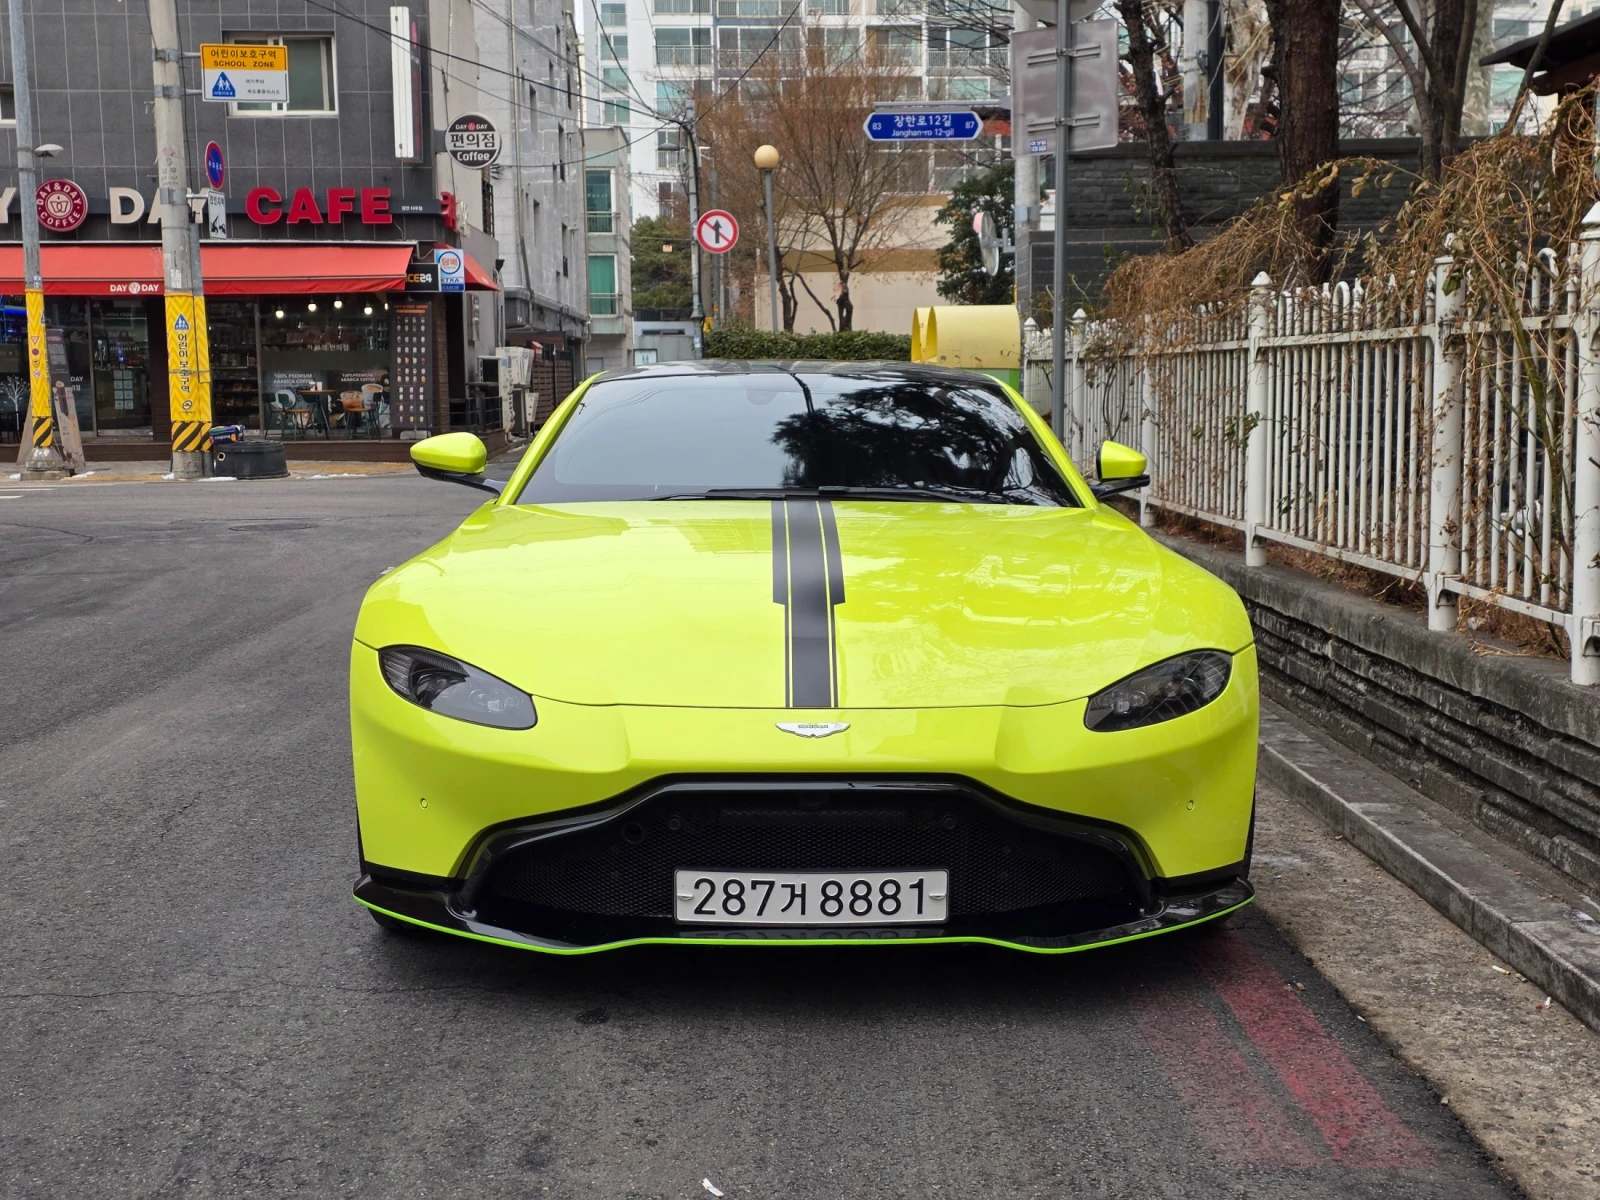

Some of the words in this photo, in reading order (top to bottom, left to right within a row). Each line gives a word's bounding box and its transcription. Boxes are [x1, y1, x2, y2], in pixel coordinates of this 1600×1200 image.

[210, 49, 276, 59] 어린이보호구역
[872, 122, 882, 130] 83
[894, 114, 952, 128] 장한로12길
[965, 120, 975, 129] 87
[891, 128, 933, 138] Janghan-ro
[450, 133, 495, 148] 편의점
[457, 151, 490, 161] Coffee
[245, 187, 393, 225] CAFE
[40, 211, 81, 227] COFFEE
[405, 273, 433, 284] CE24
[109, 284, 128, 292] DAY
[141, 284, 160, 292] DAY
[693, 877, 807, 916] 287거
[819, 877, 926, 917] 8881
